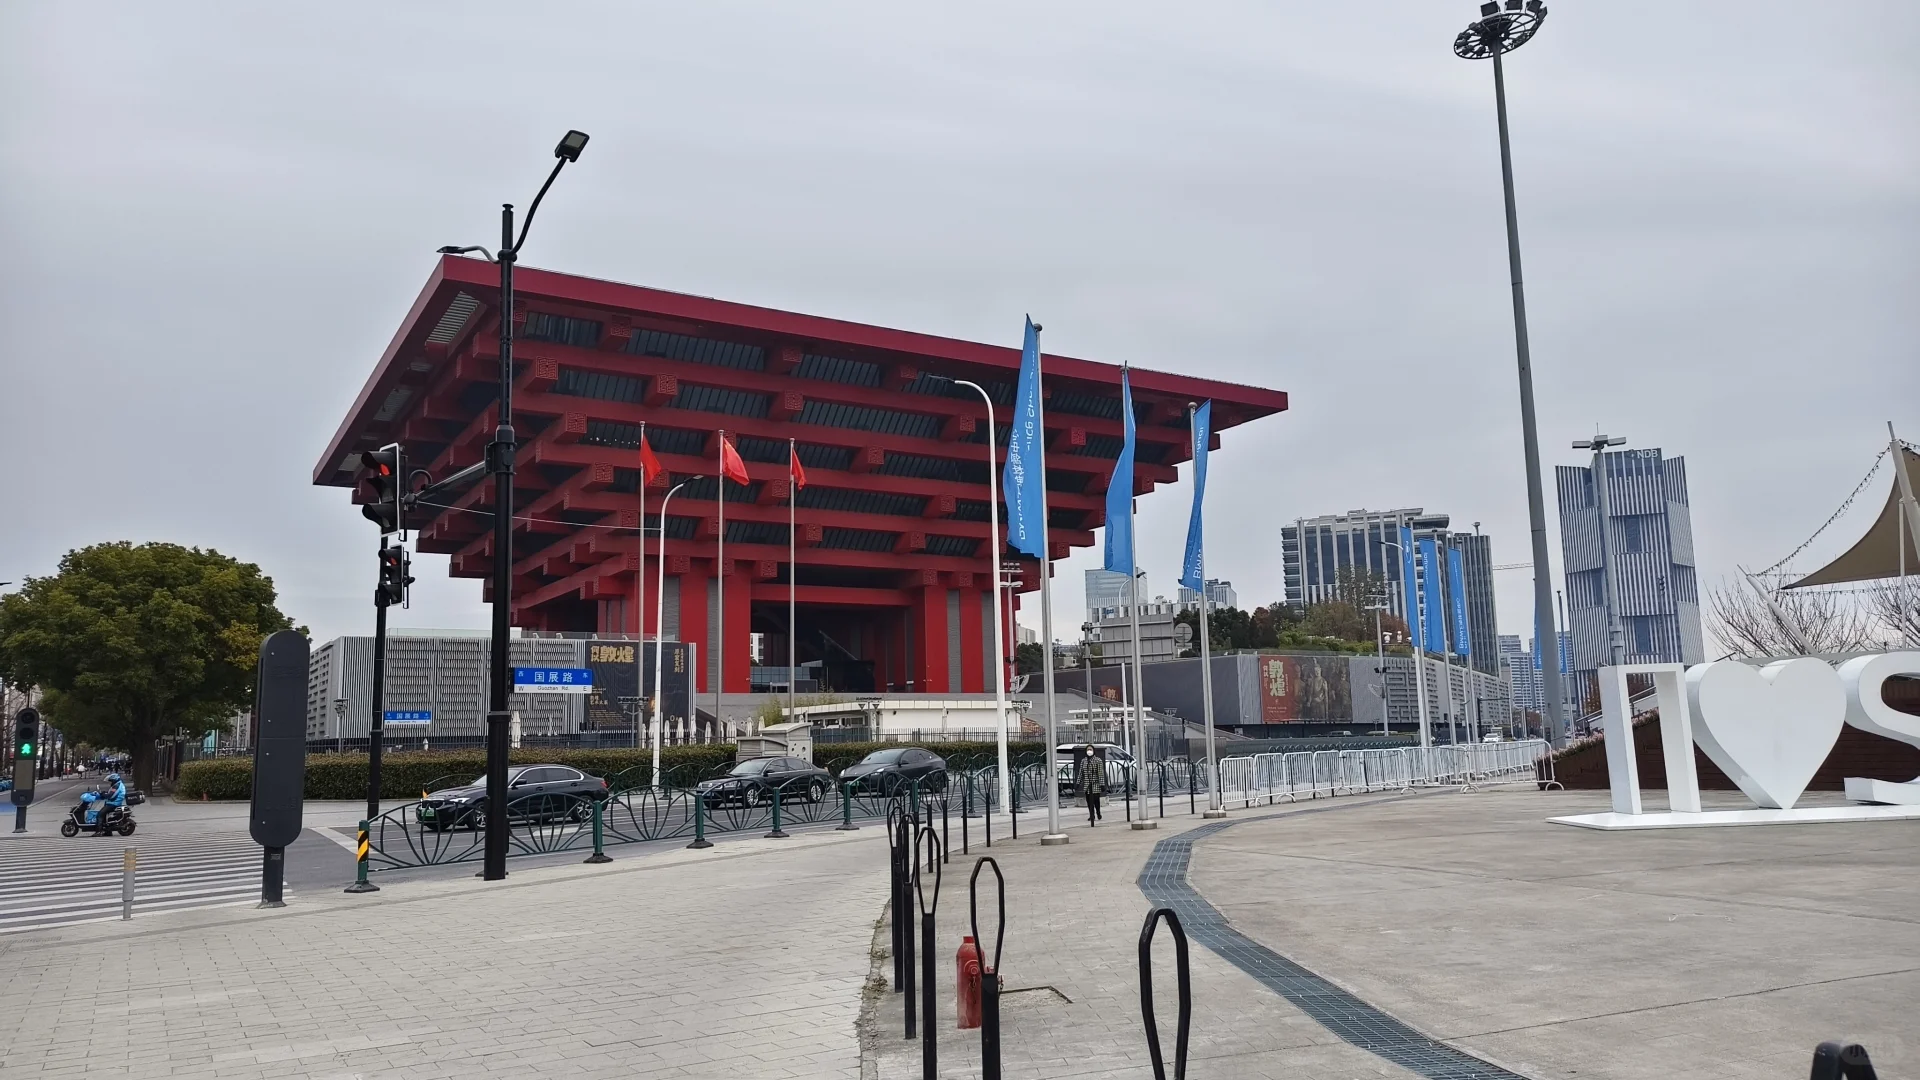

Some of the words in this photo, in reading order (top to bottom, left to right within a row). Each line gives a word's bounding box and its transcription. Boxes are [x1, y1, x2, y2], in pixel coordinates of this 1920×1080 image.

[1637, 450, 1658, 459] NDB
[534, 671, 573, 683] 国展路
